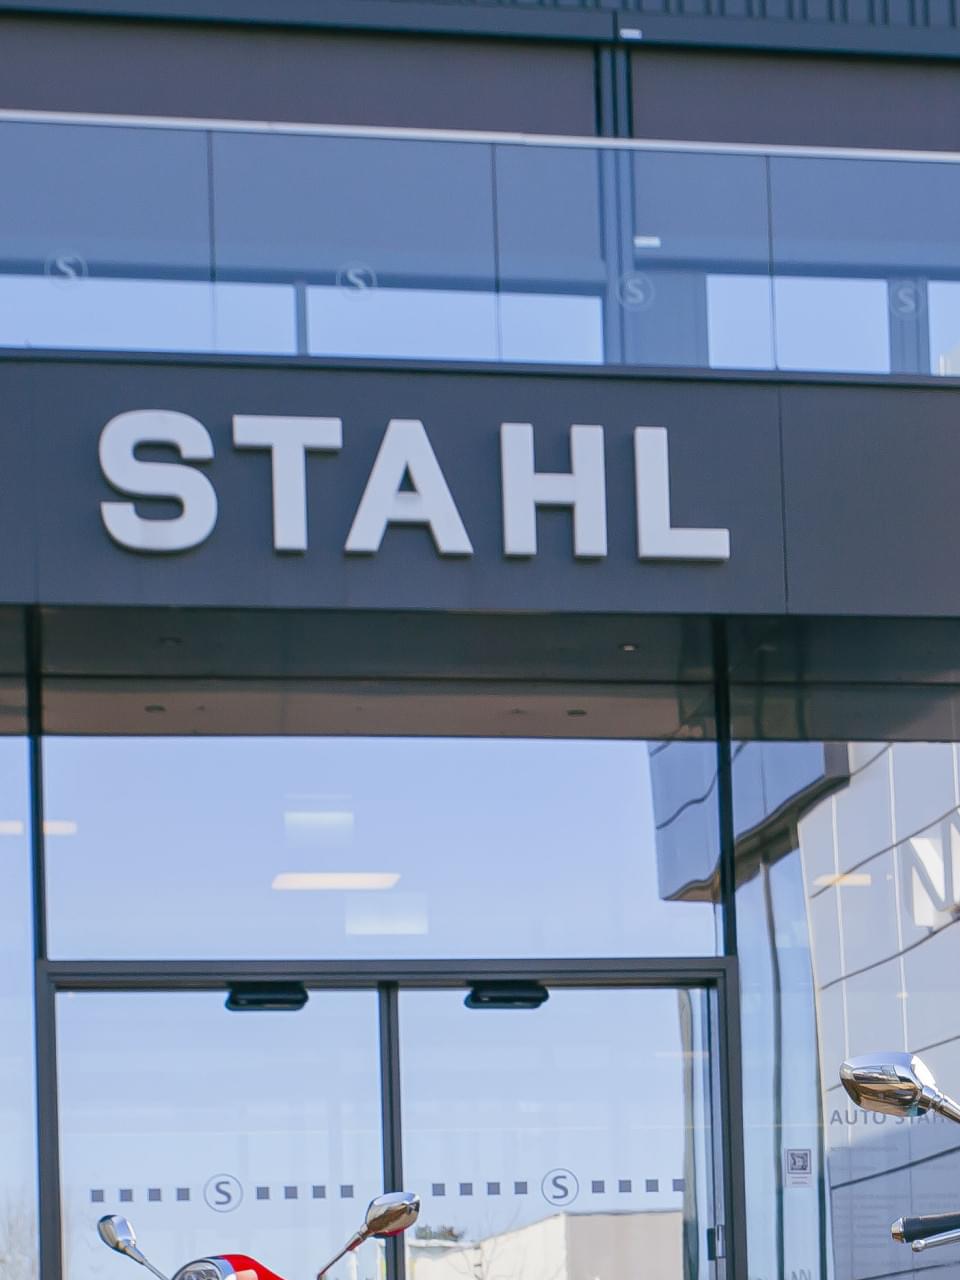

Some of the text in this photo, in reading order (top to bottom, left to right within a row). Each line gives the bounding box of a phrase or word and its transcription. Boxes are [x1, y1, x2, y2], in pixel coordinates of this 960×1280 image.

[98, 409, 731, 561] STAHL
[830, 1109, 886, 1125] AUTO
[215, 1181, 232, 1205] S
[551, 1175, 569, 1199] S
